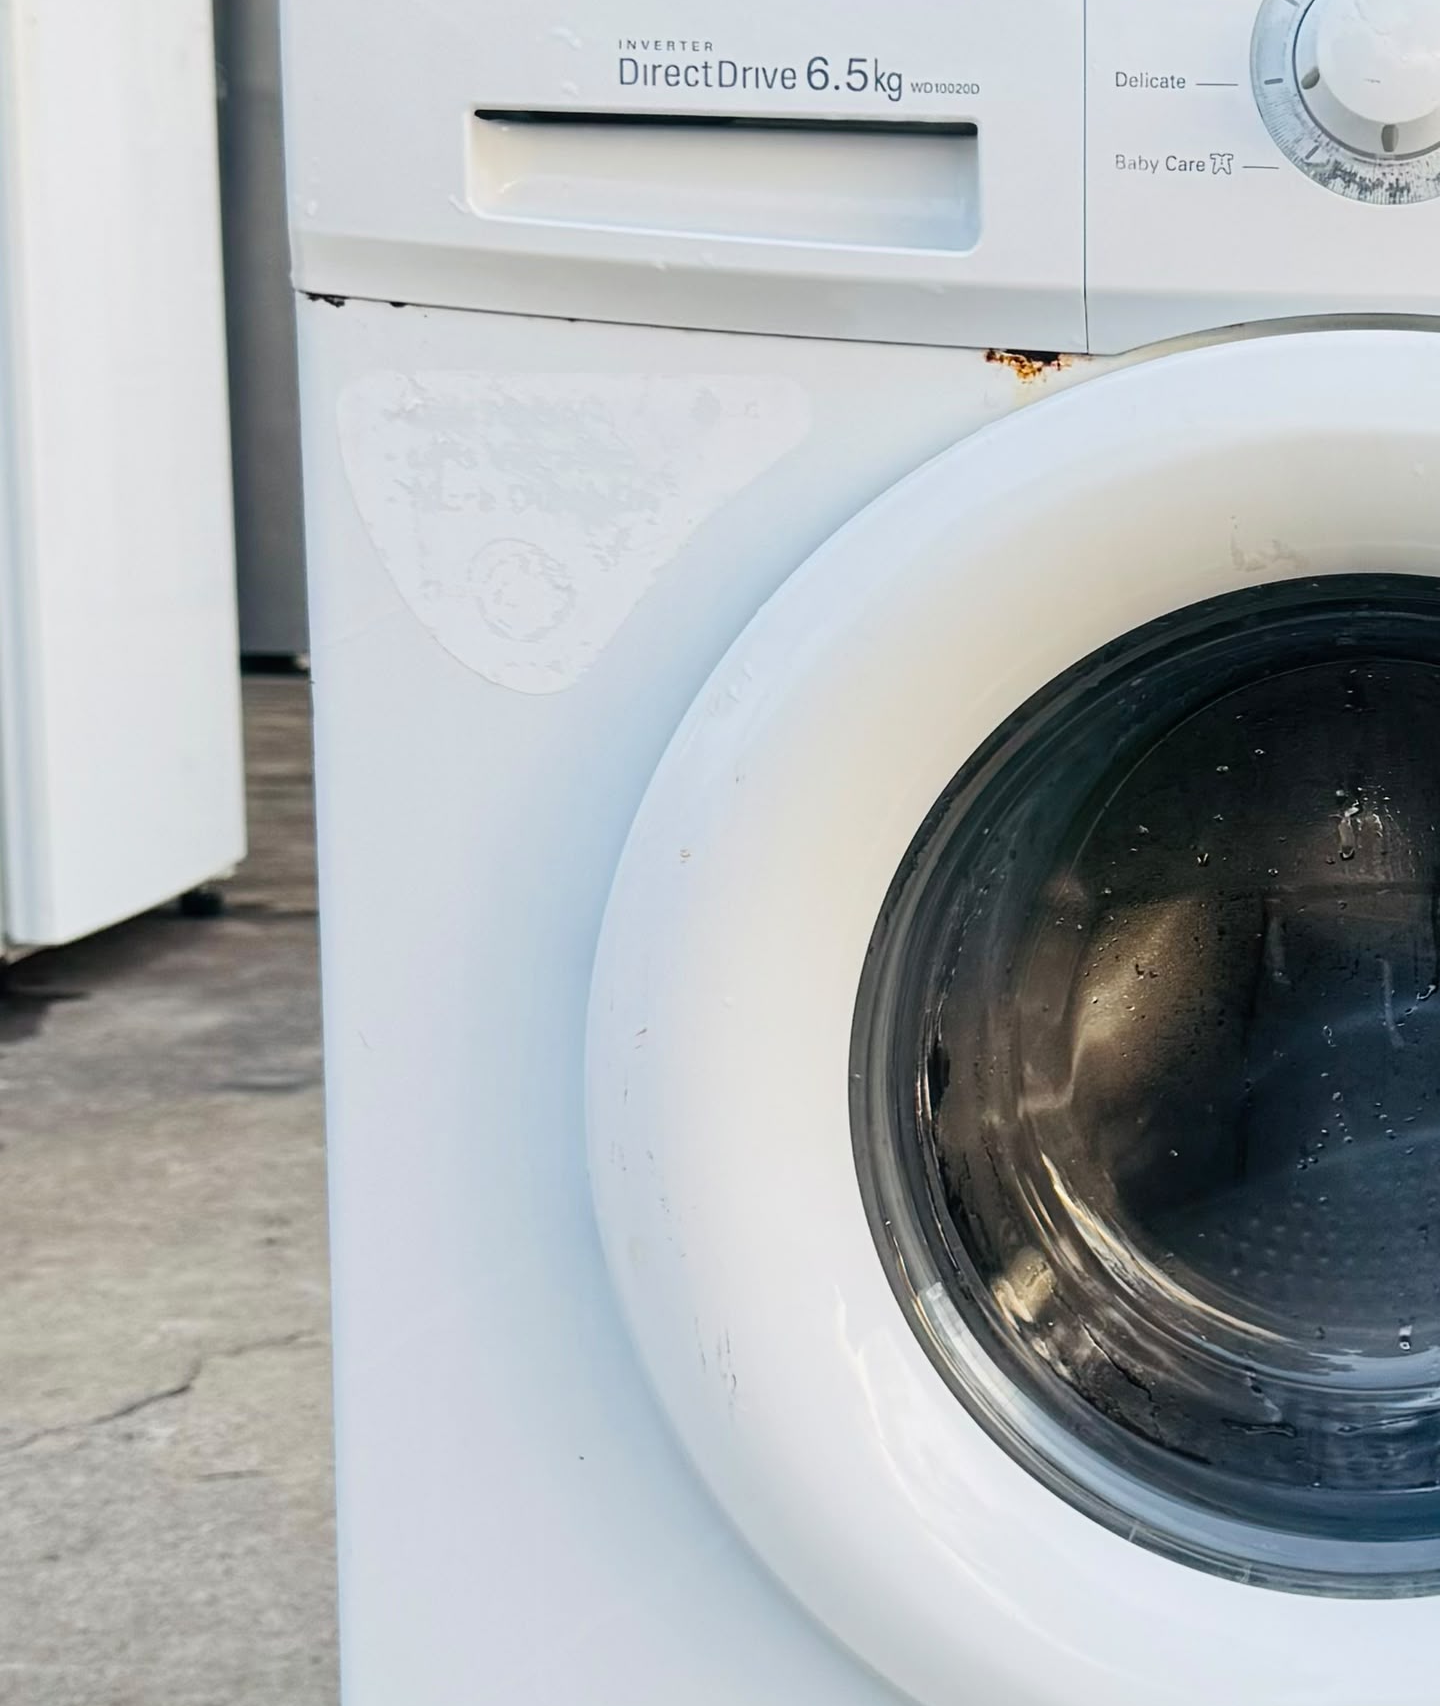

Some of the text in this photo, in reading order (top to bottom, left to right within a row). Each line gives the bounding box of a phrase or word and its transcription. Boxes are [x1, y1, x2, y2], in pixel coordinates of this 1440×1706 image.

[618, 39, 713, 52] INVERTER
[910, 81, 980, 95] WD10020D
[1115, 71, 1186, 89] Delicate
[1115, 154, 1206, 174] Baby Care
